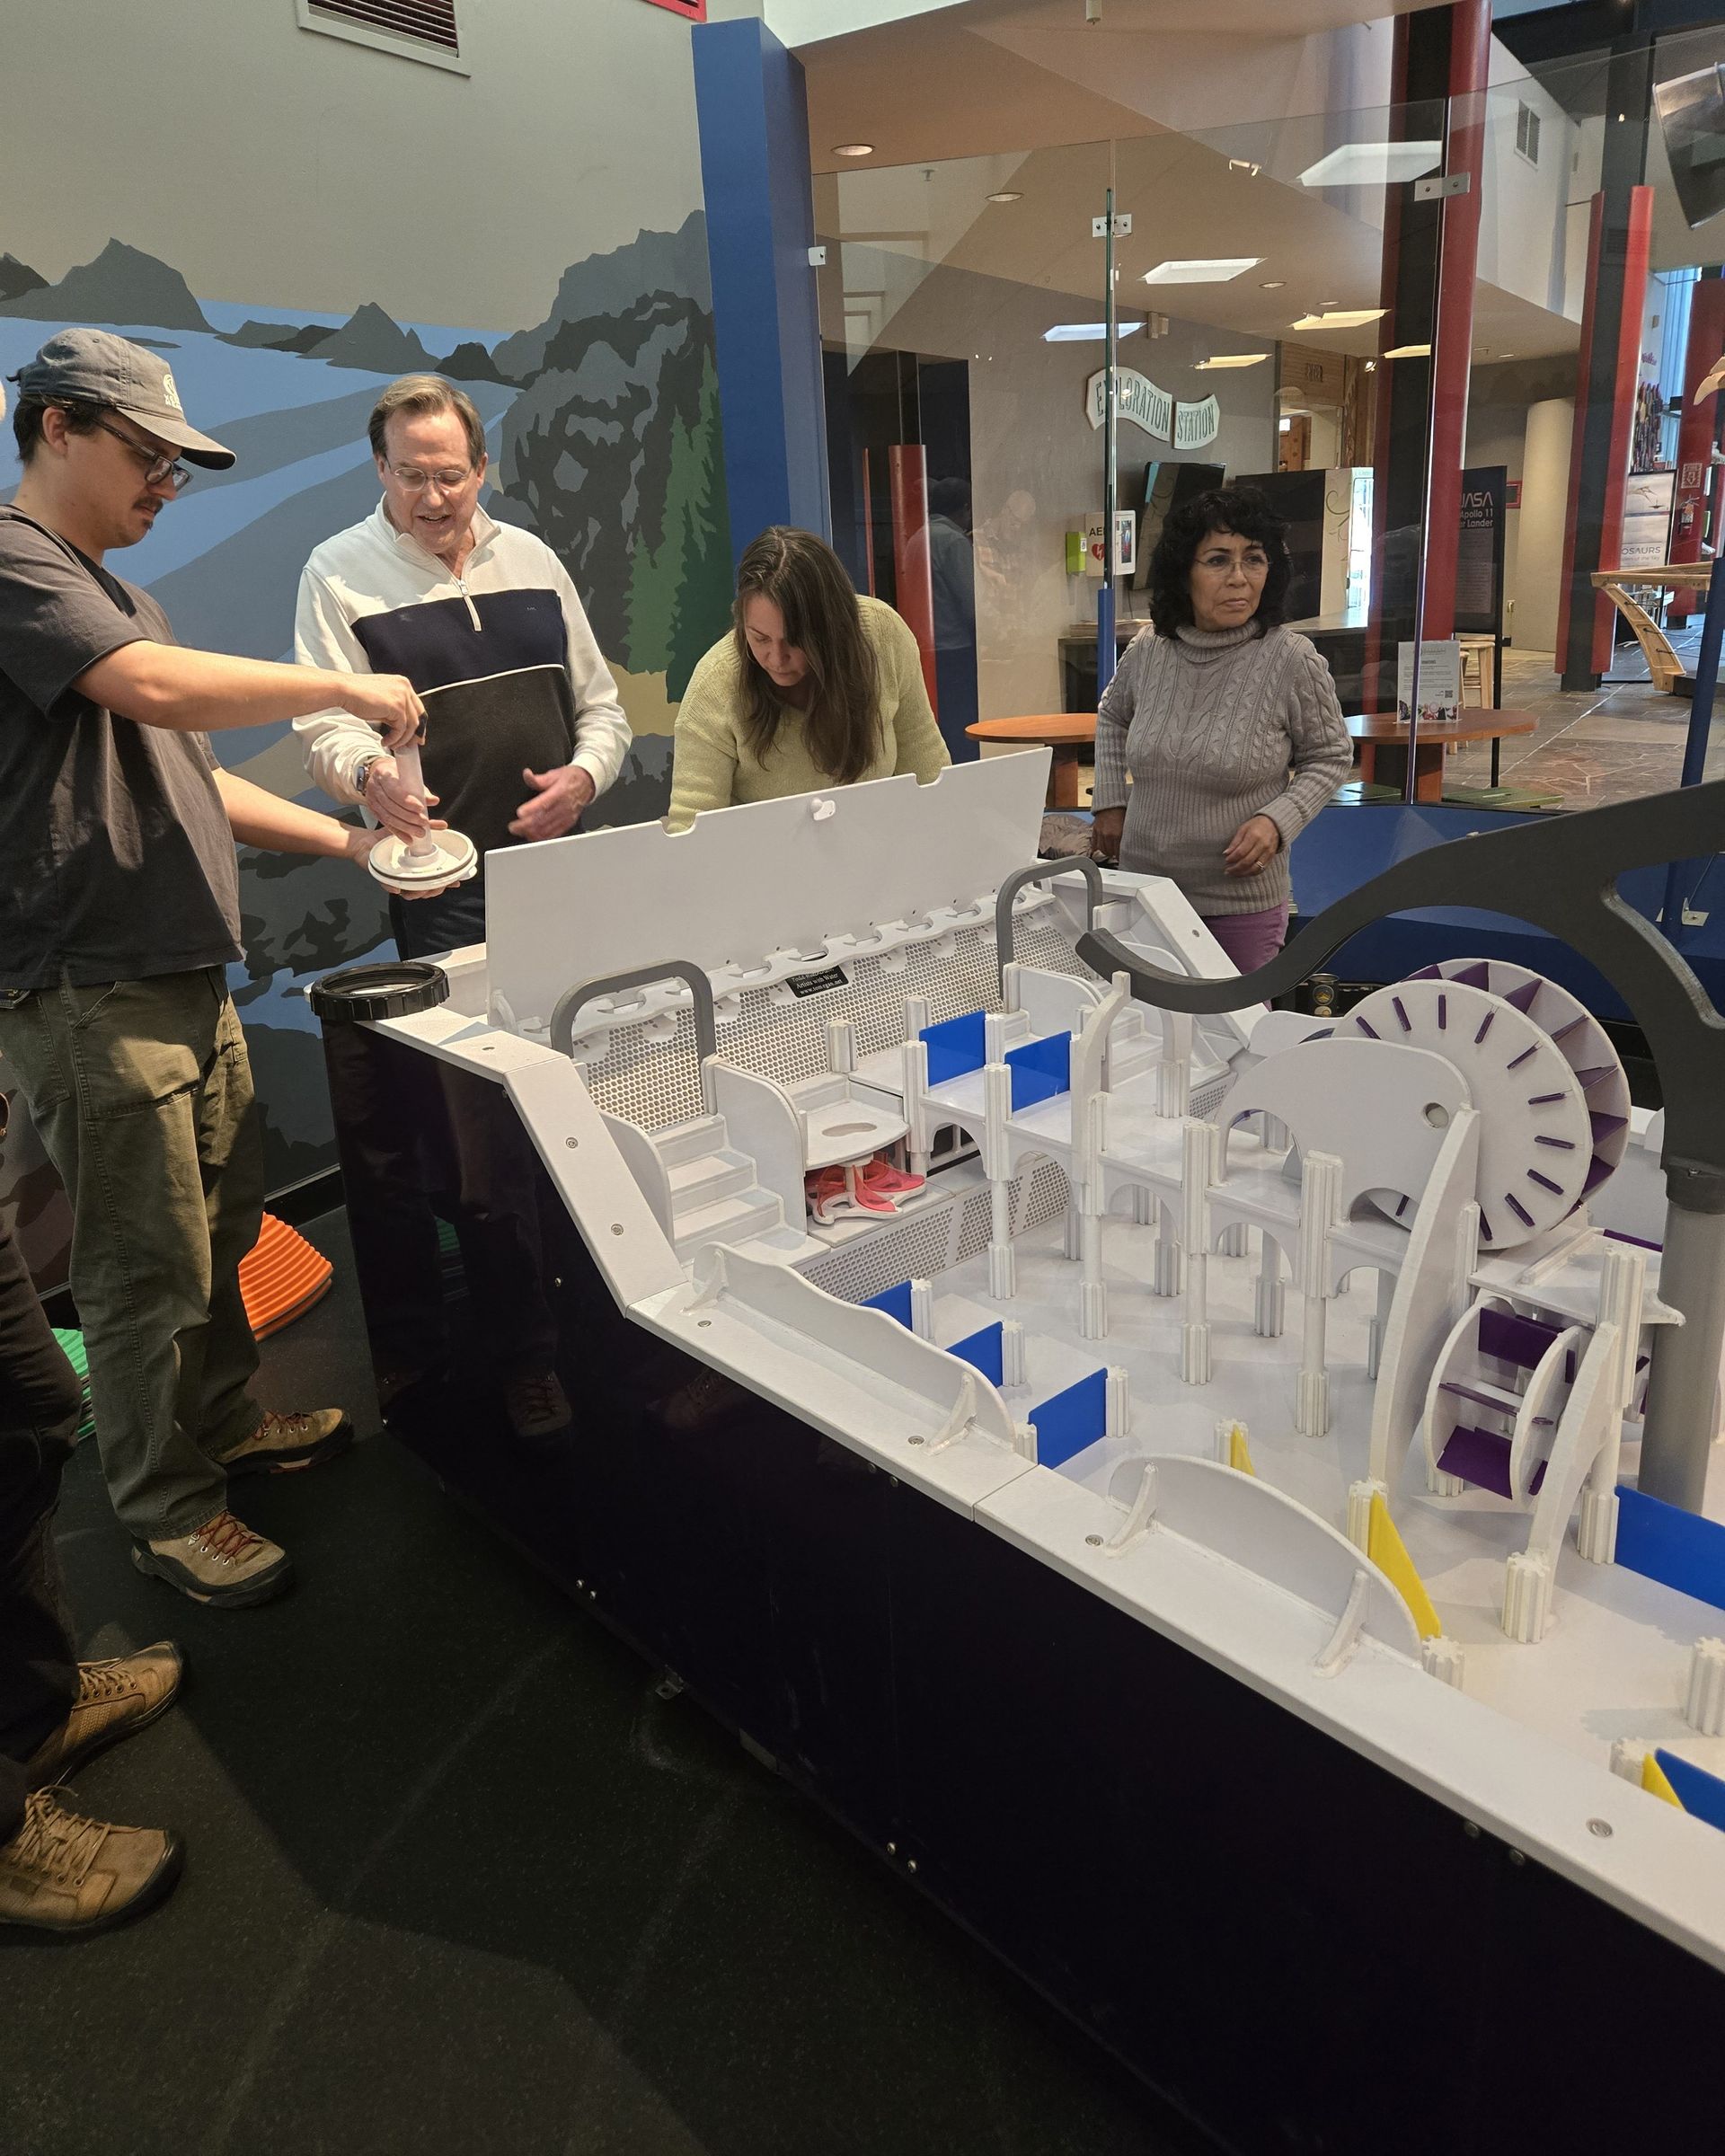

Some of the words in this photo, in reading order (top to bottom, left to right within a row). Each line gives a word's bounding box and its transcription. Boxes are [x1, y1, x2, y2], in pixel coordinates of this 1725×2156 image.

[1095, 376, 1171, 433] ELORATION
[1177, 402, 1215, 443] STATION
[1485, 508, 1493, 517] 11
[1467, 518, 1493, 528] Lander
[1089, 526, 1104, 537] AE
[1621, 546, 1661, 555] OSAURS
[796, 981, 813, 990] Artists
[812, 976, 825, 985] with
[822, 973, 838, 981] Water
